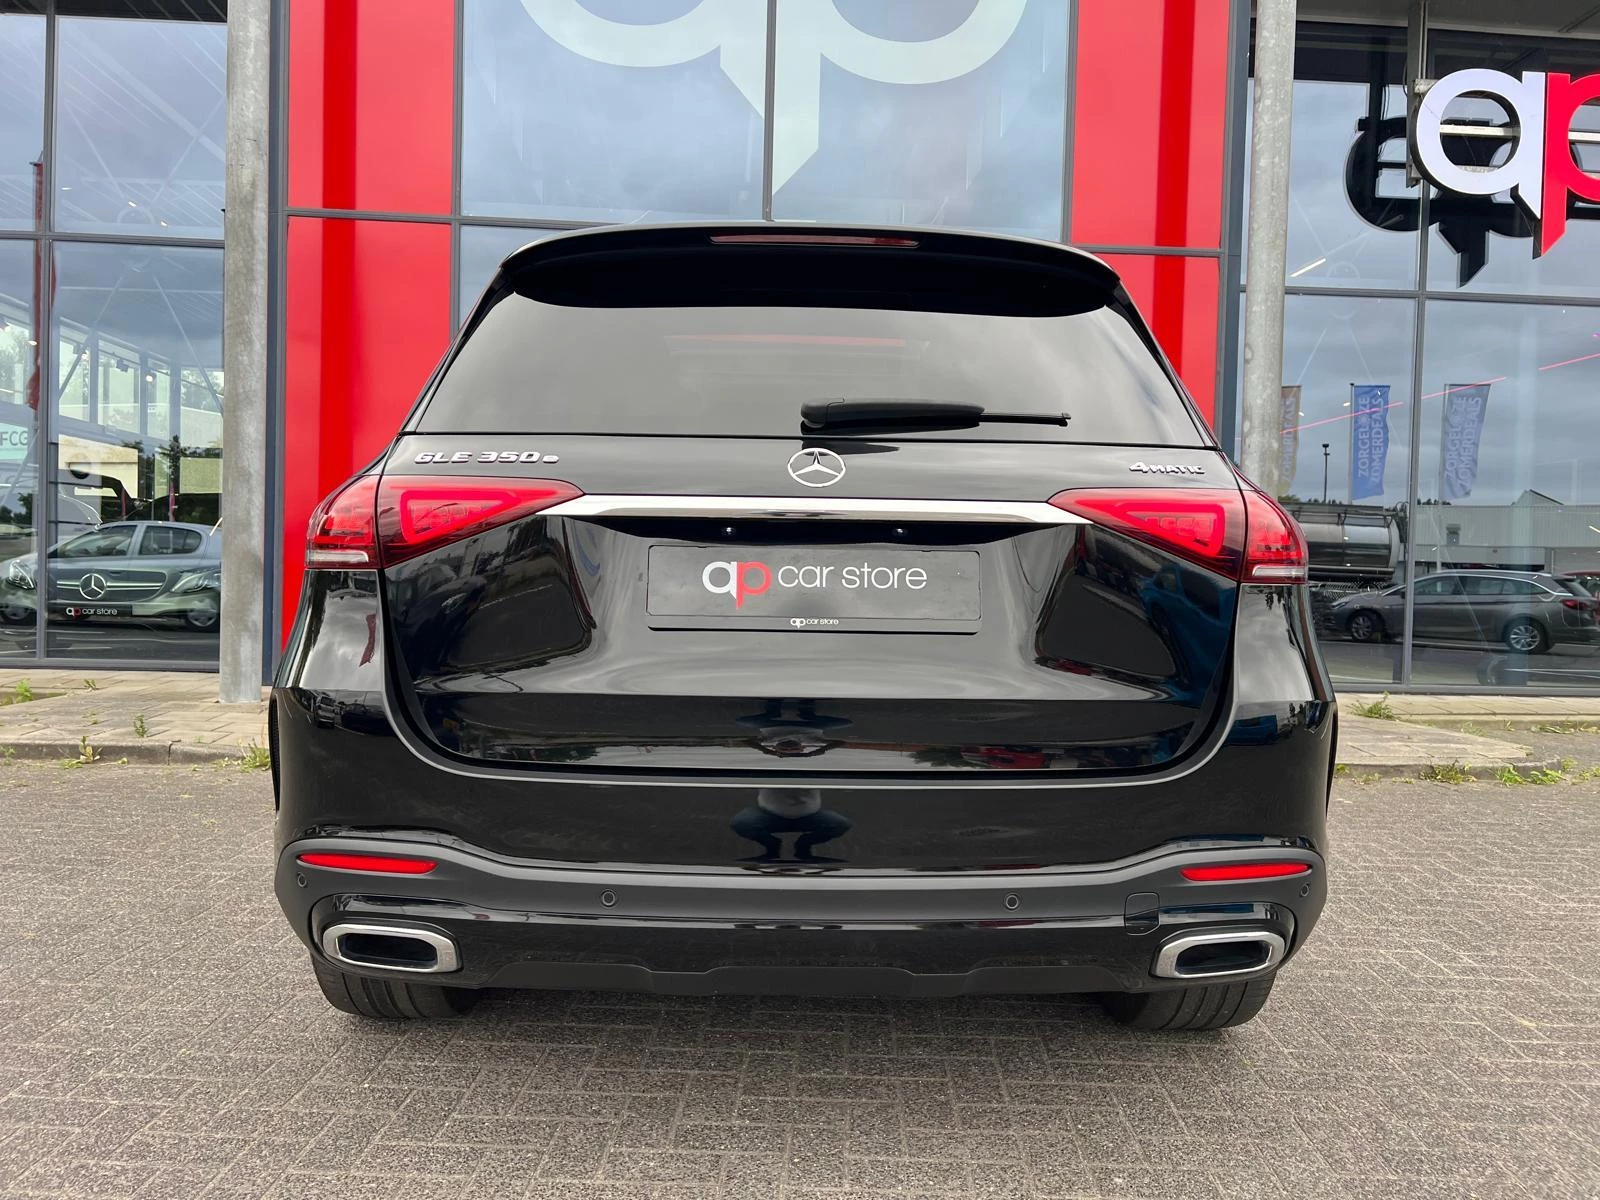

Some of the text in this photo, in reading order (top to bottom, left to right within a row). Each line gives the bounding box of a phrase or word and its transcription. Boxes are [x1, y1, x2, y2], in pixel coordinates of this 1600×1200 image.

[414, 451, 473, 464] GLE
[1128, 461, 1205, 474] 4MATIC
[778, 565, 834, 588] car
[841, 562, 928, 590] store
[96, 607, 118, 616] store
[819, 618, 839, 626] store
